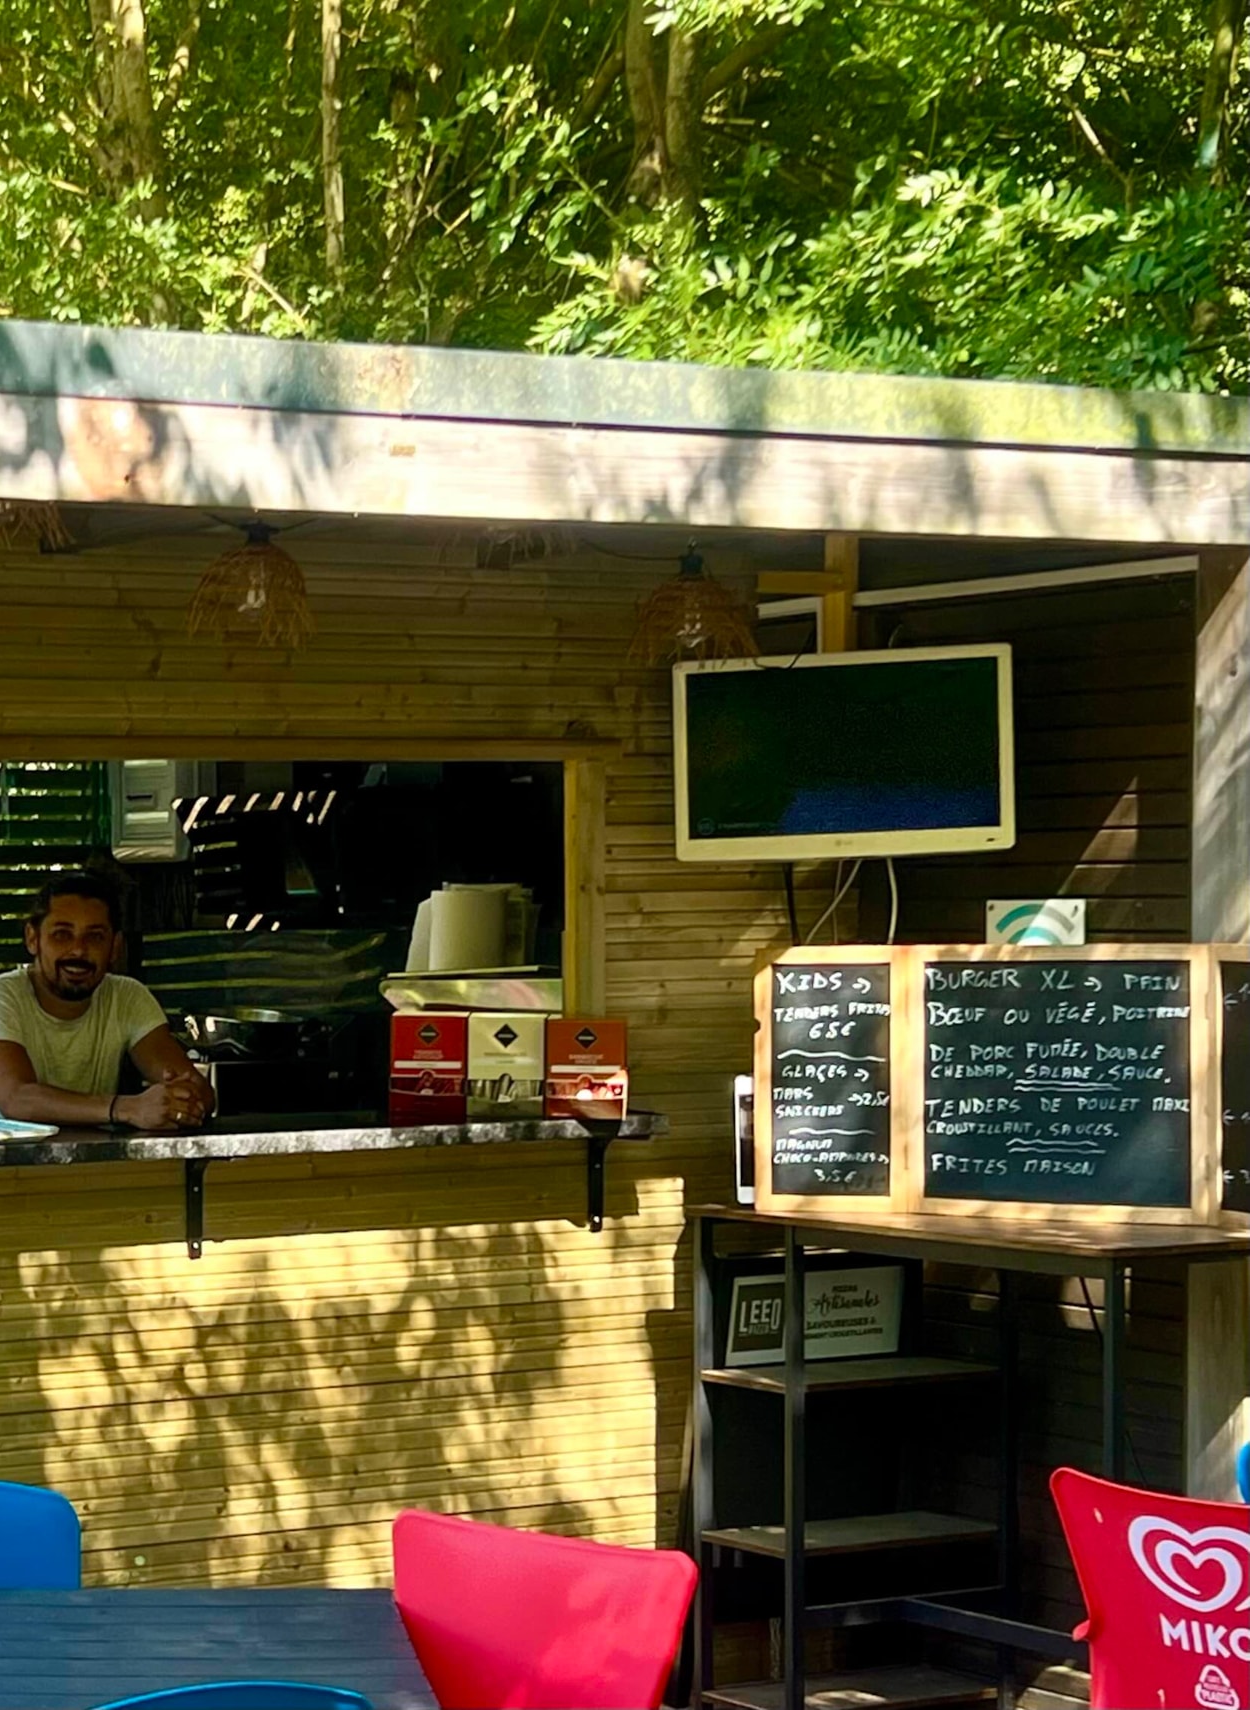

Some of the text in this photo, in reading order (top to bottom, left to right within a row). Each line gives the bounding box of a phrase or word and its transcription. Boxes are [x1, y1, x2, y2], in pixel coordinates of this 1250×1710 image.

[775, 972, 842, 994] KIDS
[925, 968, 1075, 991] BURGER XL
[773, 1004, 839, 1022] TENDERS
[1003, 1008, 1030, 1025] OU
[929, 1043, 955, 1062] DE
[969, 1044, 1015, 1061] PORC
[1095, 1043, 1166, 1062] DOUBLE
[773, 1086, 814, 1100] MARS
[775, 1104, 844, 1119] SNICKERS
[925, 1097, 1022, 1118] TENDERS
[1040, 1097, 1062, 1113] DE
[1077, 1097, 1141, 1112] POULET
[775, 1138, 833, 1151] MAGNUM
[931, 1153, 1095, 1176] FRITES MAISON
[1159, 1612, 1250, 1662] MIKO
